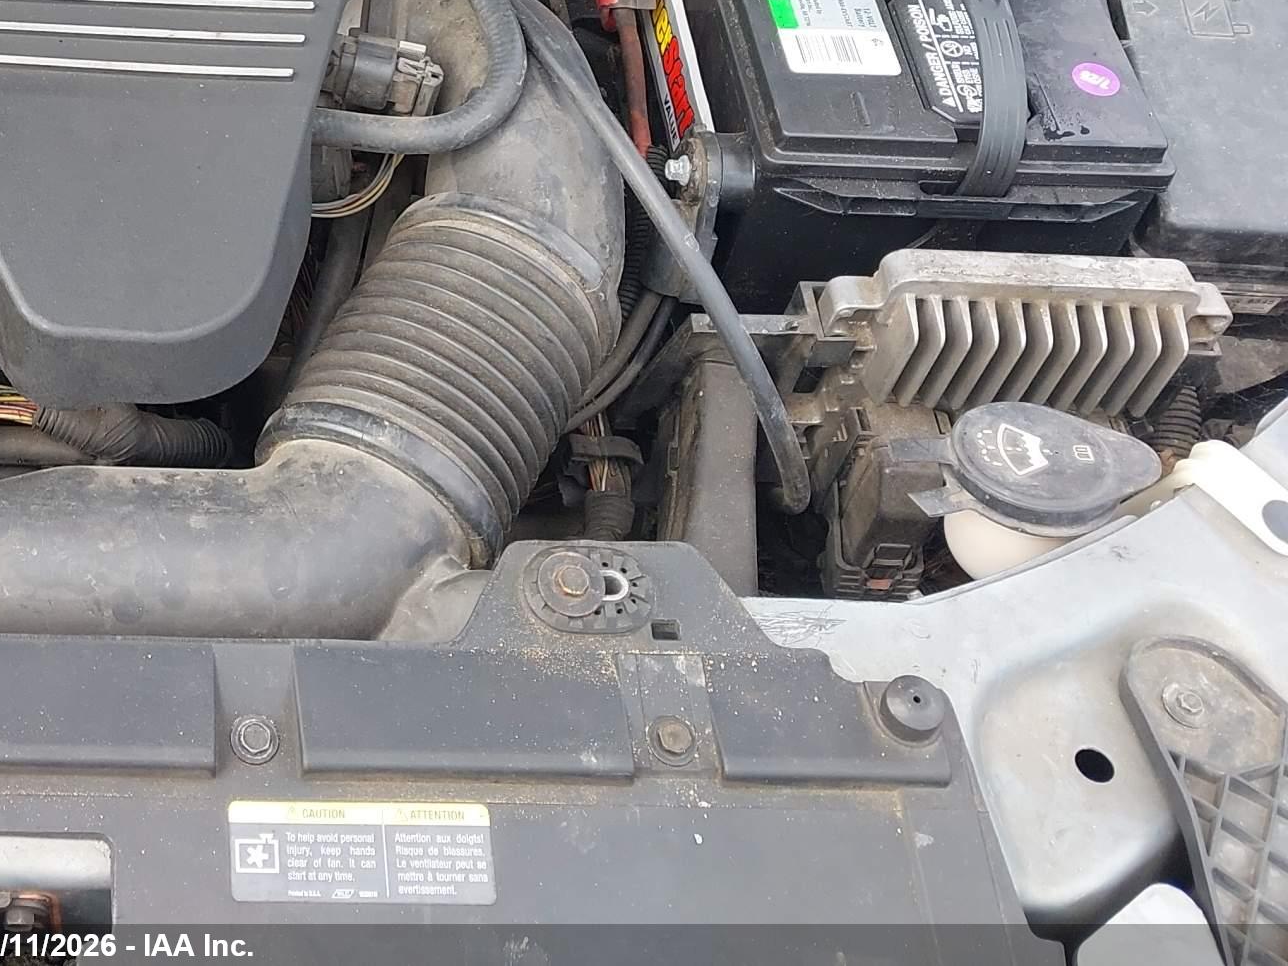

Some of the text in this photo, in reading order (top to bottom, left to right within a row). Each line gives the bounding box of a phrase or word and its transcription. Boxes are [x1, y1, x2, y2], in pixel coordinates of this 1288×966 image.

[906, 3, 931, 42] POISON
[924, 51, 952, 96] DANGER
[663, 94, 680, 148] VALUE
[302, 808, 346, 819] CAUTION
[410, 809, 465, 821] ATTENTION
[286, 831, 375, 846] To help avoid personal
[394, 832, 432, 844] Attention
[435, 834, 452, 844] aux
[320, 845, 342, 858] keep
[349, 845, 376, 857] hands
[395, 845, 424, 858] Risque
[427, 845, 439, 857] de
[287, 858, 307, 869] clear
[313, 858, 323, 869] of
[327, 858, 344, 869] fan.
[361, 859, 377, 869] can
[396, 858, 487, 872] Le ventilateur peut se
[287, 870, 356, 884] start at any time.
[397, 871, 424, 882] mettre
[435, 872, 466, 883] tourner
[468, 873, 489, 883] sans
[398, 884, 457, 896] avertissement.
